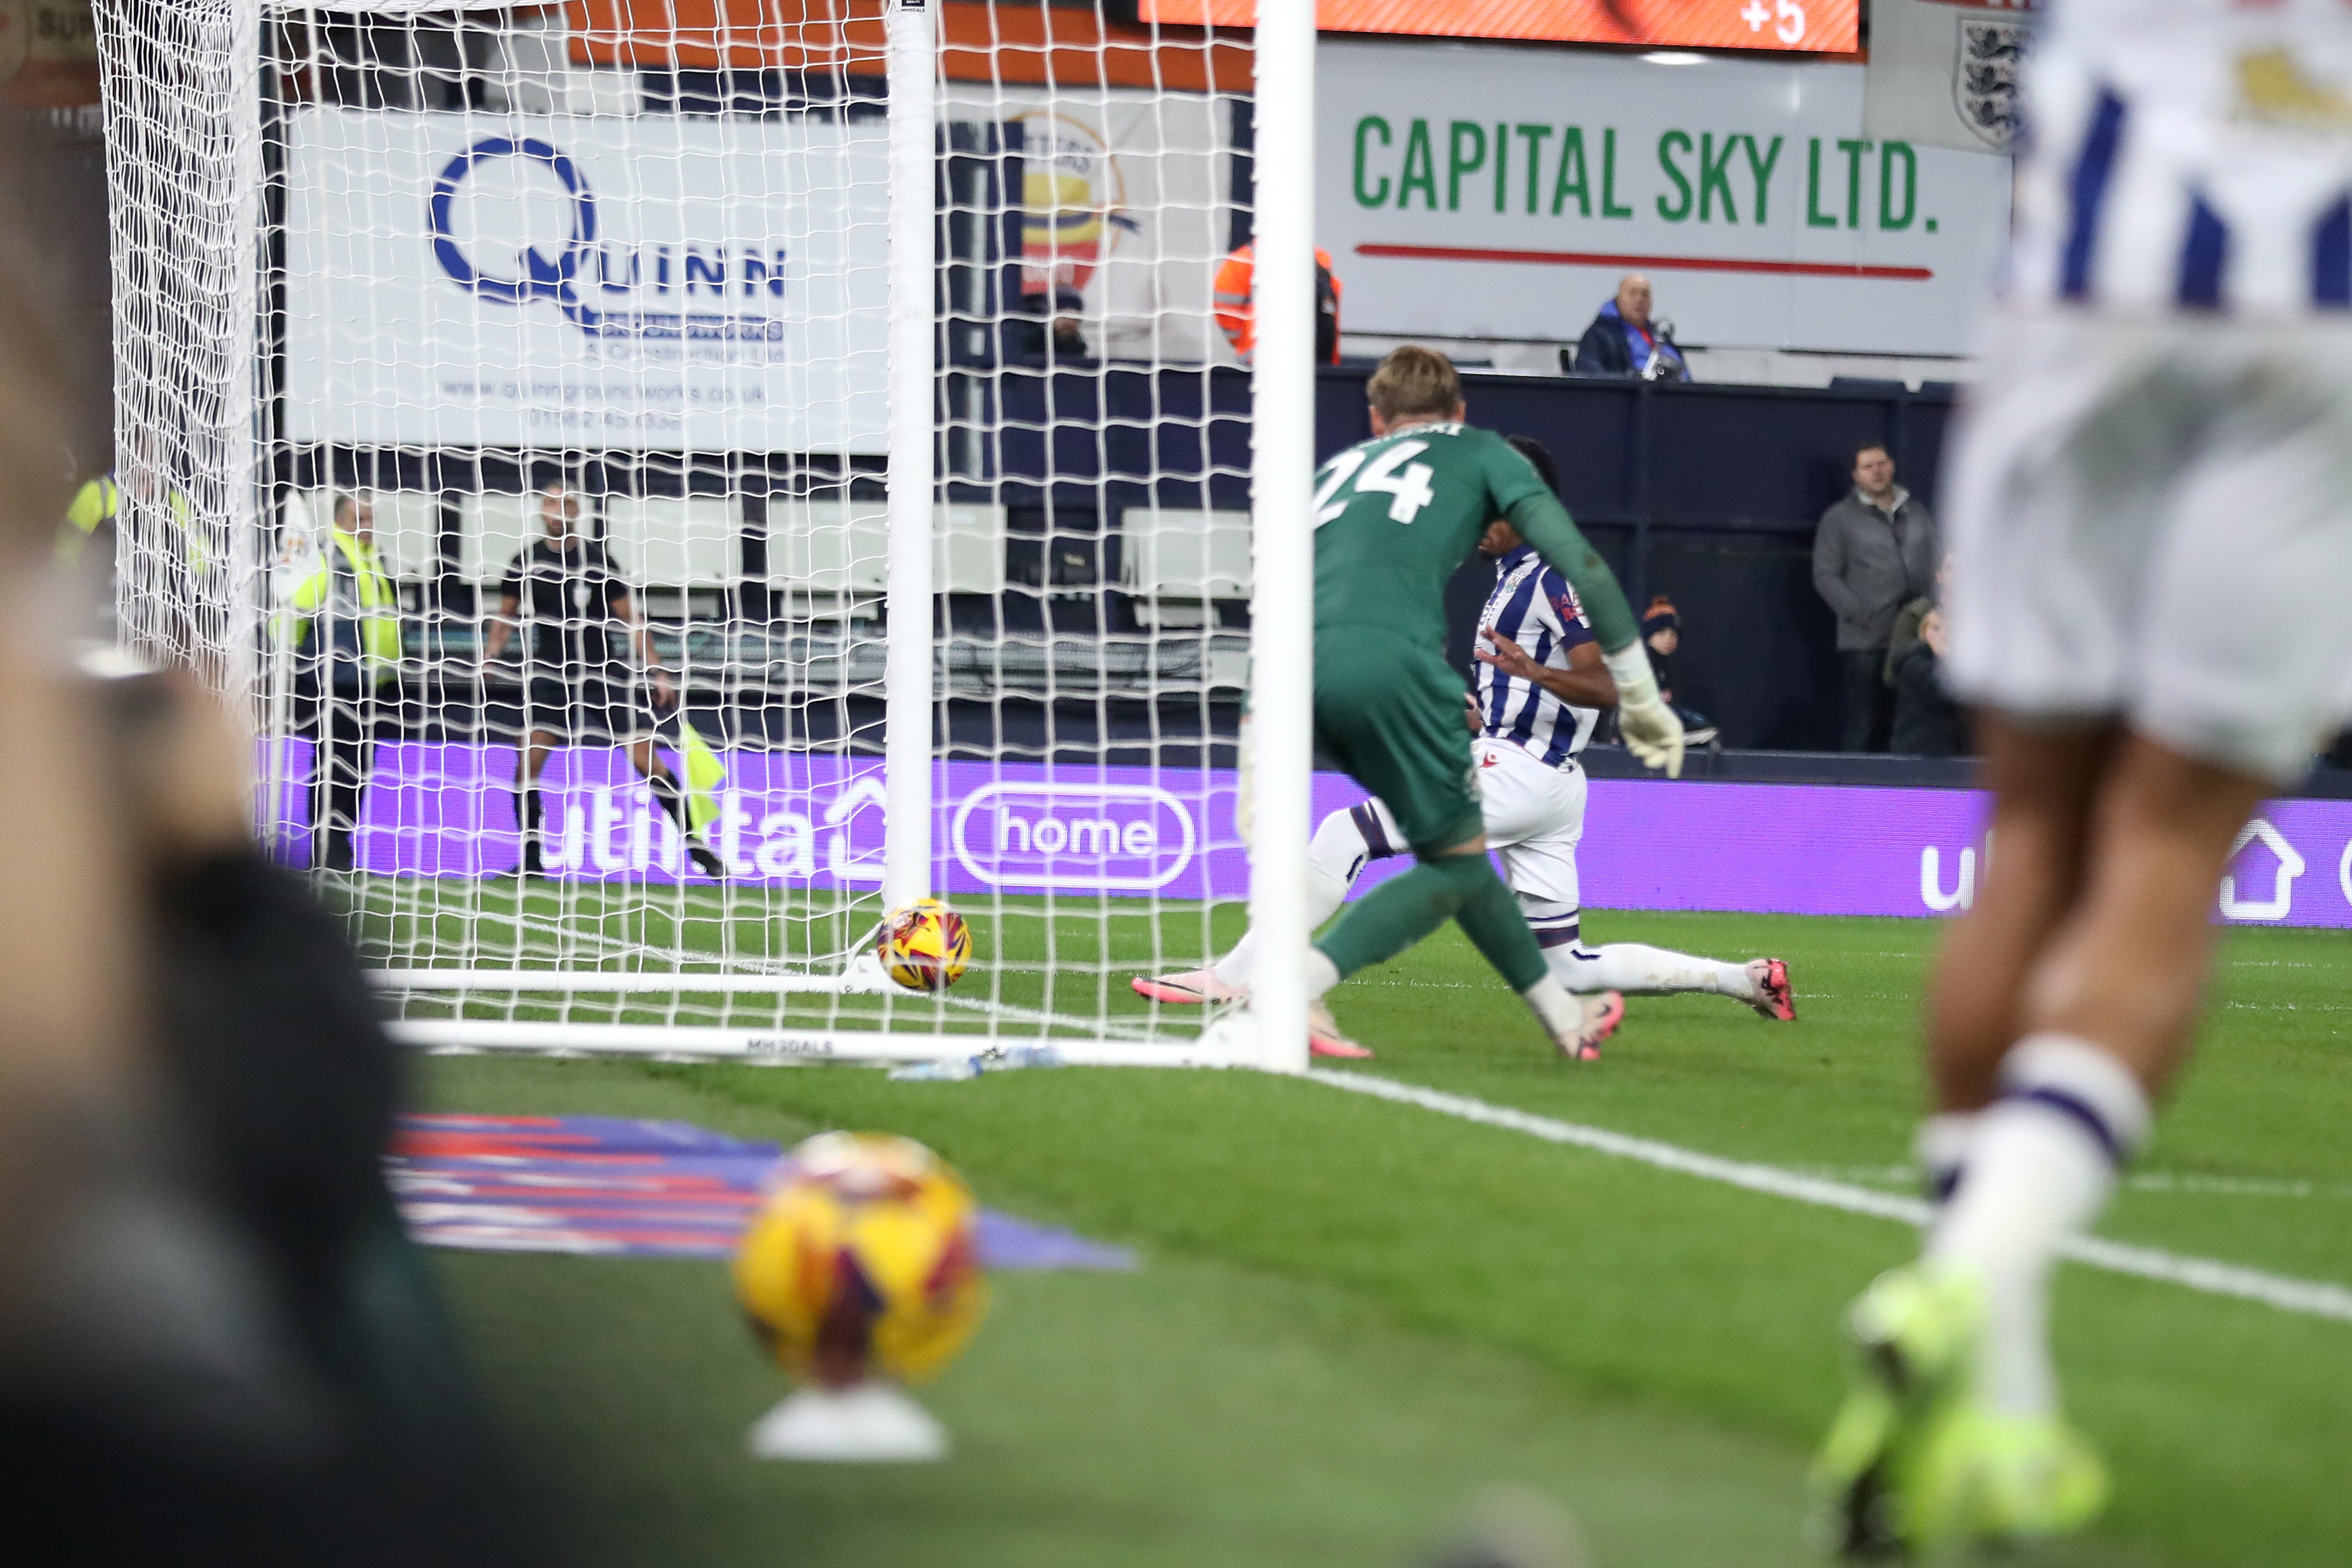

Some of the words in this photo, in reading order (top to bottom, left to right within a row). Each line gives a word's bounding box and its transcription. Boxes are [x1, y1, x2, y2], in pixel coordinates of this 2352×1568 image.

[1353, 114, 1634, 219] CAPITAL
[1656, 128, 1784, 225] SKY
[1806, 137, 1939, 233] LTD.
[428, 135, 787, 334] QUINN
[1314, 439, 1436, 527] 24
[999, 805, 1159, 857] home
